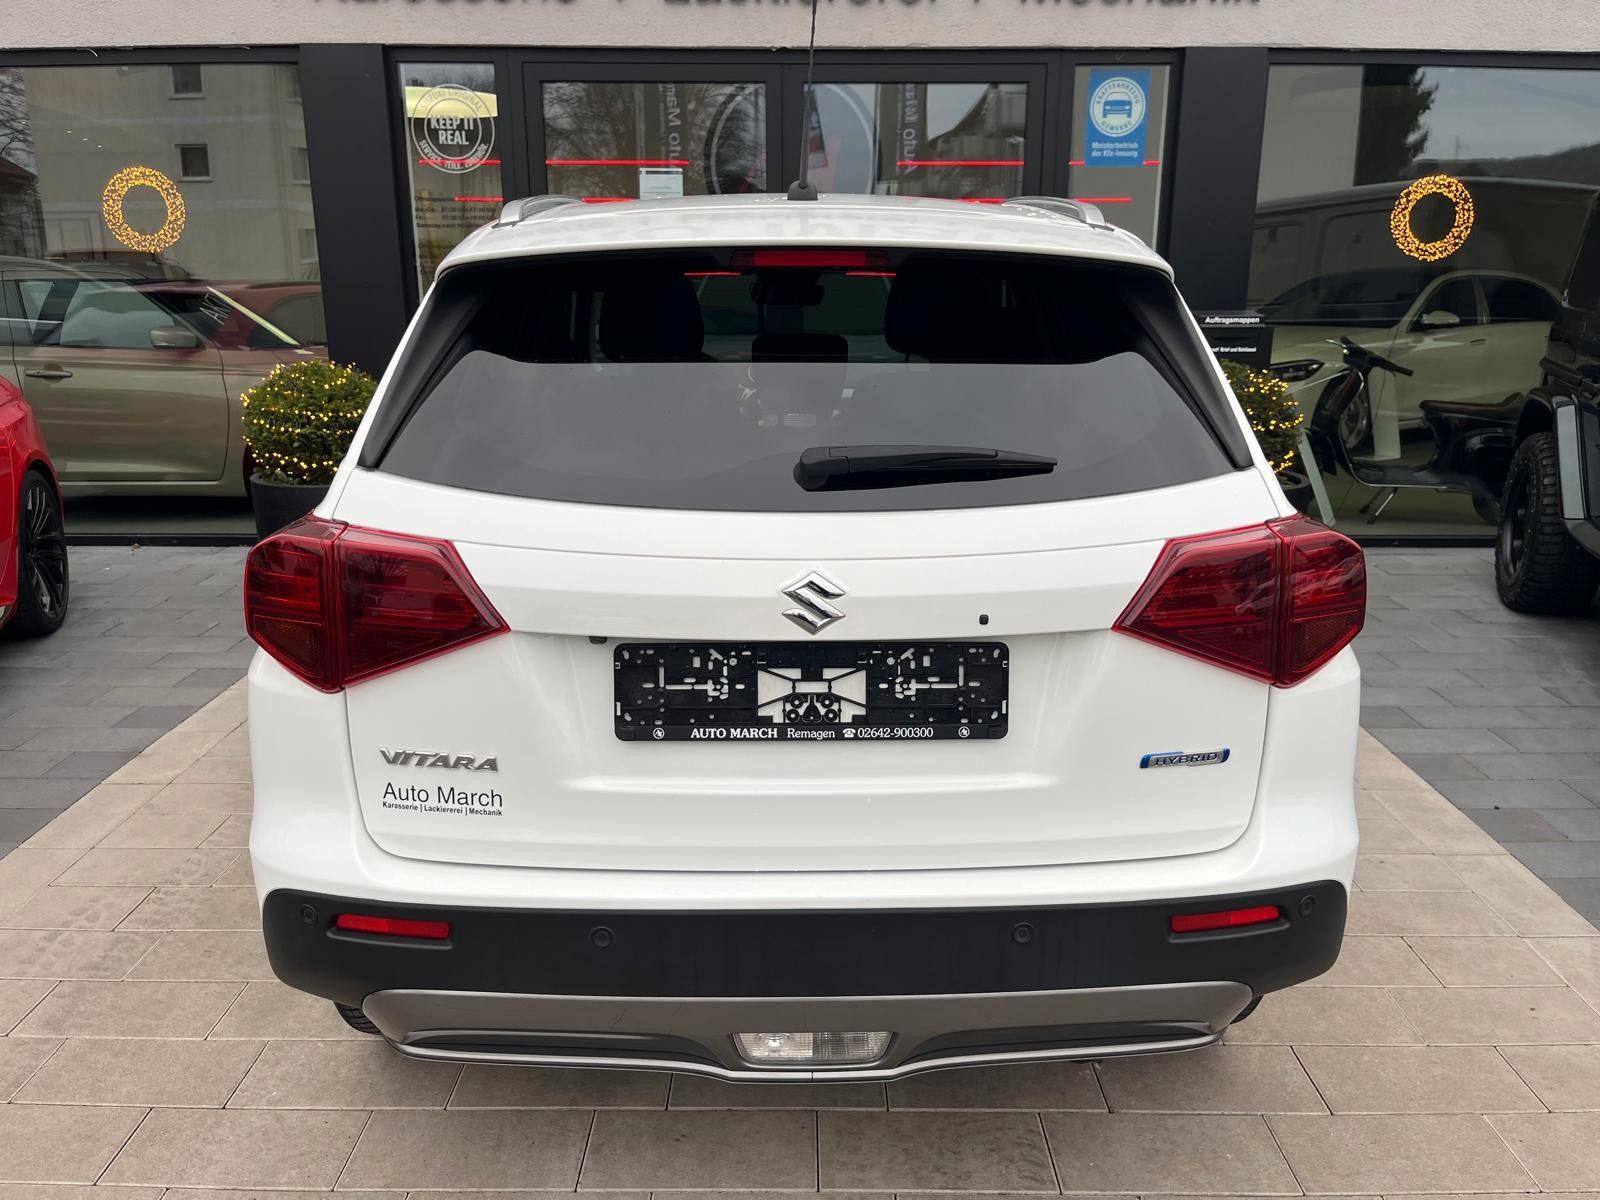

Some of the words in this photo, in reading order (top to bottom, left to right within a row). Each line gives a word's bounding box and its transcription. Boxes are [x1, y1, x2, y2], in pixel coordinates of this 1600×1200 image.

[430, 114, 461, 130] KEEP
[438, 130, 470, 145] REAL
[1204, 316, 1260, 325] Auftragsmappen
[690, 727, 727, 739] AUTO
[729, 727, 778, 739] MARCH
[787, 727, 836, 741] Remagen
[857, 726, 934, 739] 02642-900300
[379, 746, 499, 773] VITARA
[1154, 751, 1219, 766] HYBRID
[383, 781, 429, 803] Auto
[436, 785, 503, 808] March
[382, 800, 419, 811] Karosserie
[424, 804, 463, 815] Lackiererei
[468, 807, 503, 817] Mechanik
